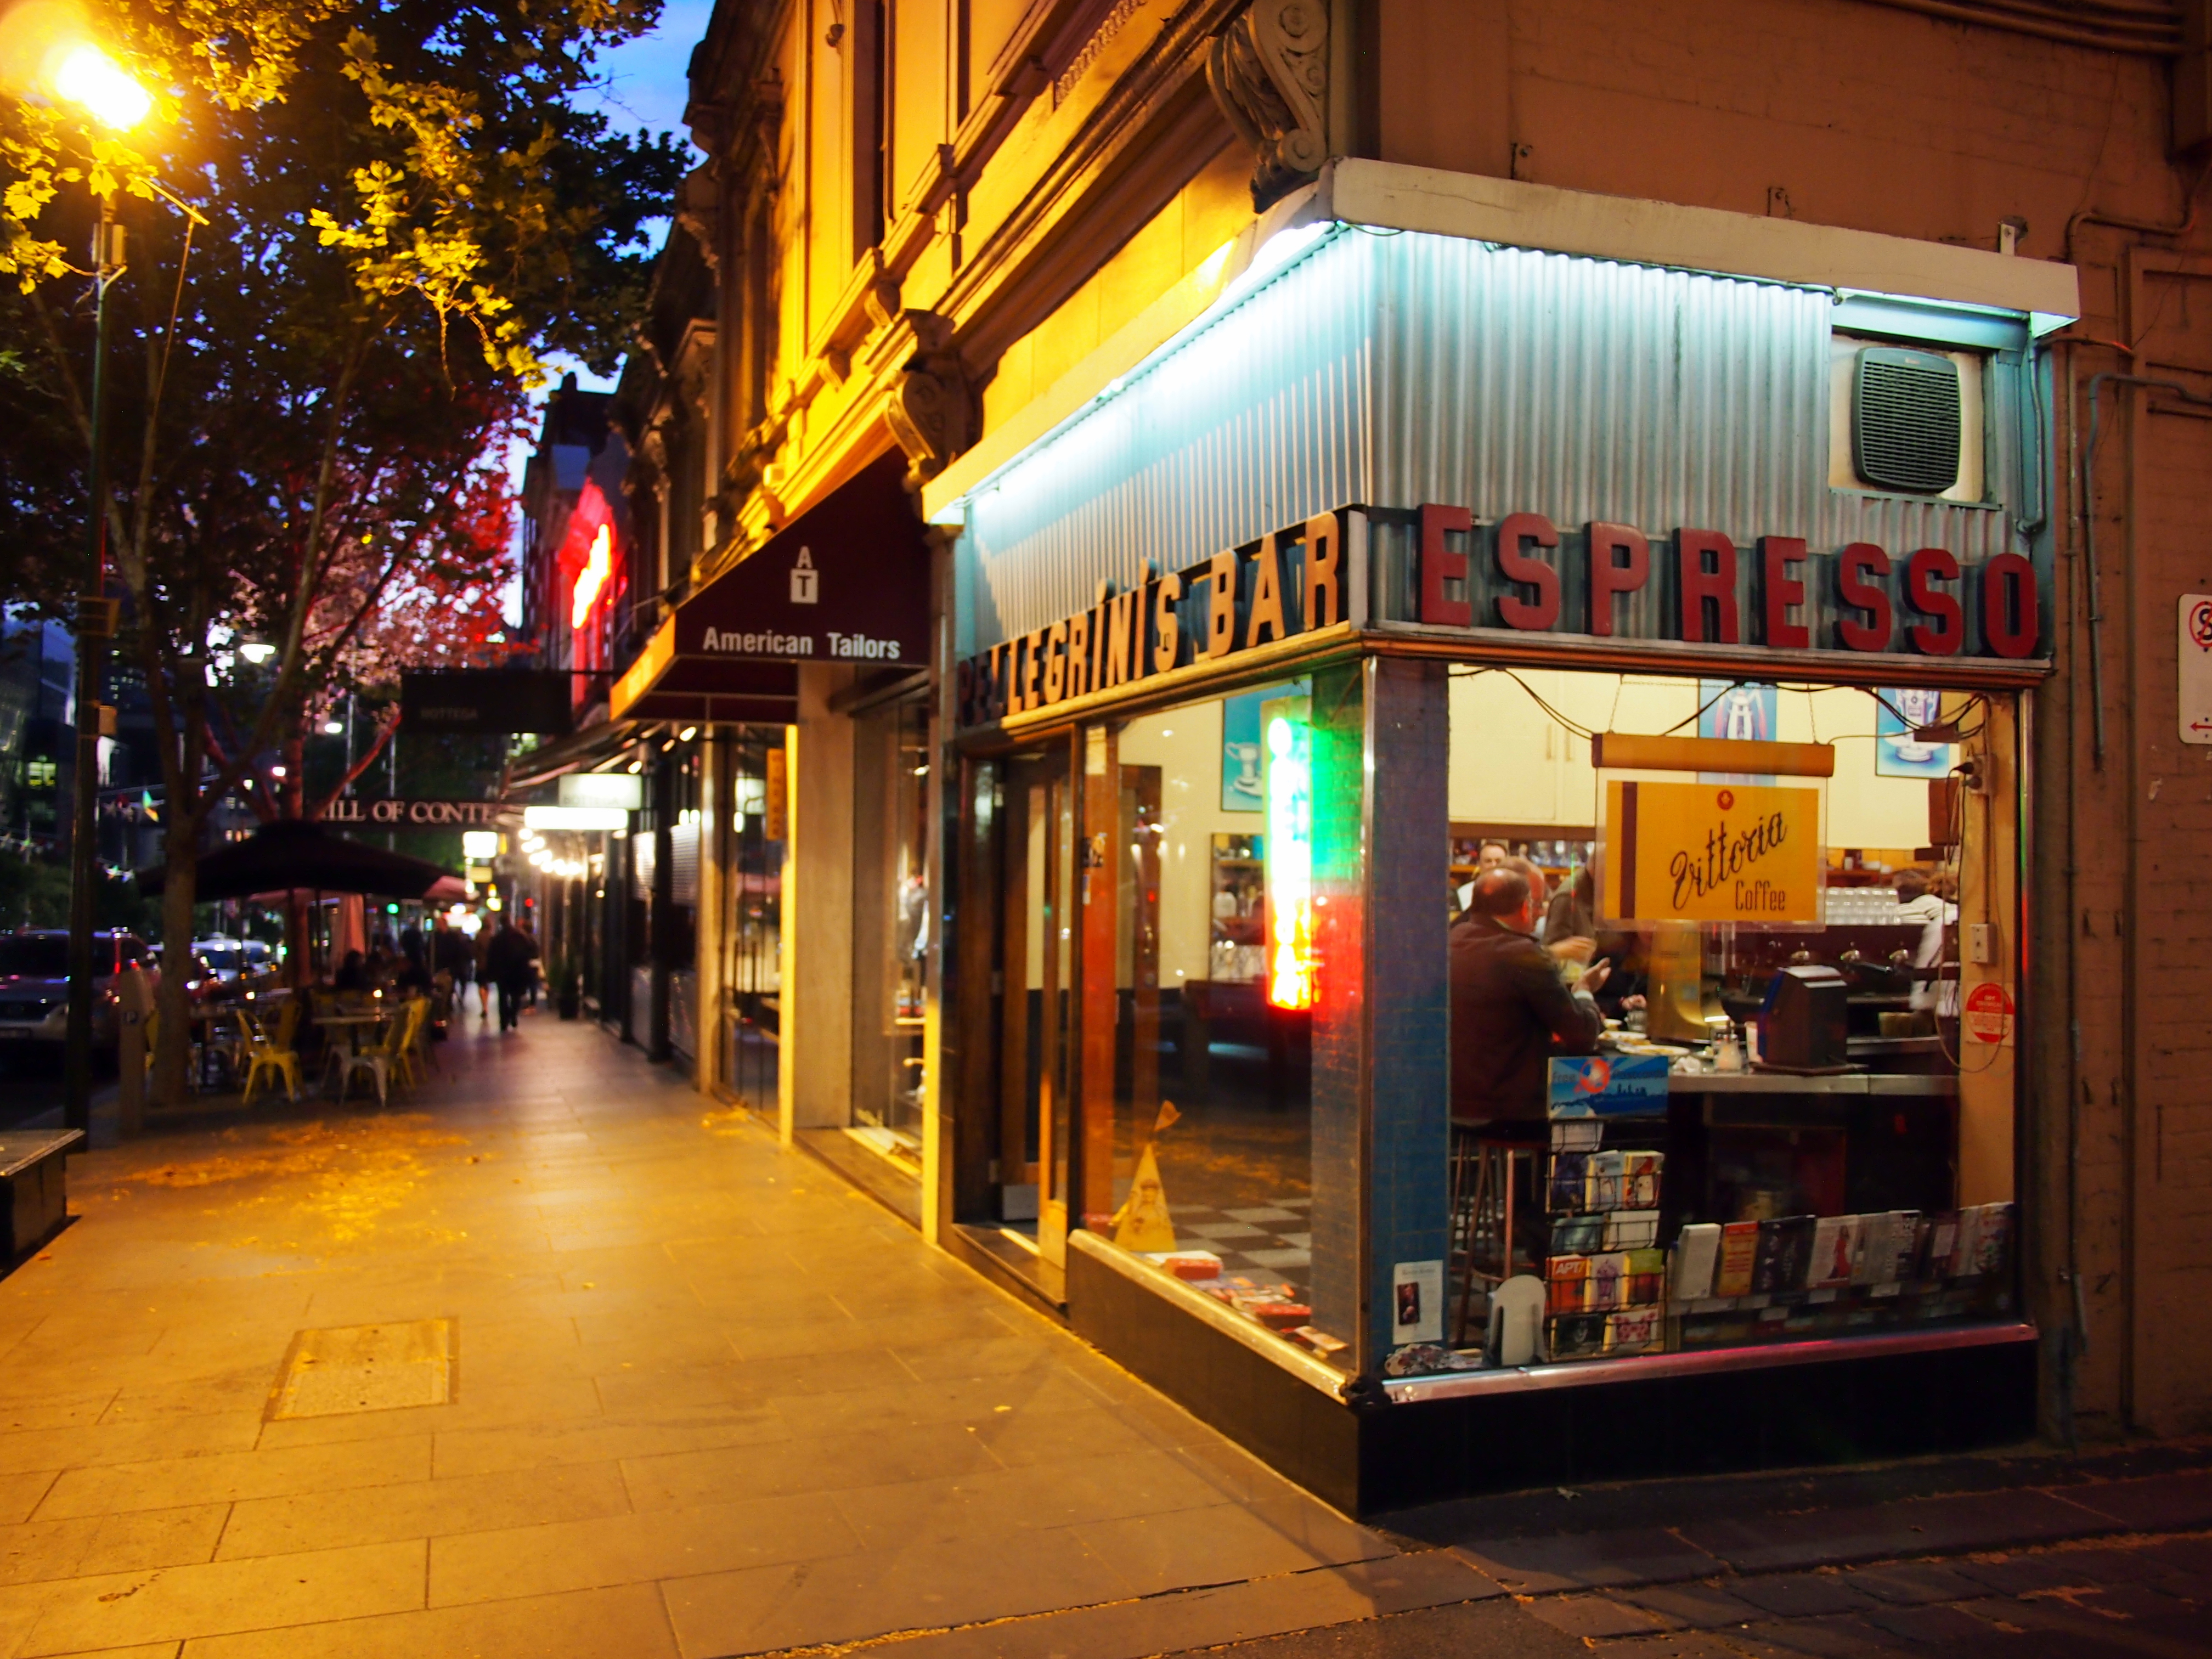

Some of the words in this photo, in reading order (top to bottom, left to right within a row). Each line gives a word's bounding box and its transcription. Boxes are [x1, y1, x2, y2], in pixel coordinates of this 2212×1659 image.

[797, 546, 812, 569] A
[796, 574, 812, 597] T
[1209, 511, 1340, 659] BAR
[1417, 504, 2039, 658] ESPRESSO
[703, 627, 812, 656] American
[827, 632, 901, 660] Tailors
[321, 799, 366, 822] ILL
[372, 800, 405, 823] OF
[410, 801, 497, 825] CONTE
[1671, 812, 1787, 911] Vittoria
[1735, 880, 1786, 911] Coffee
